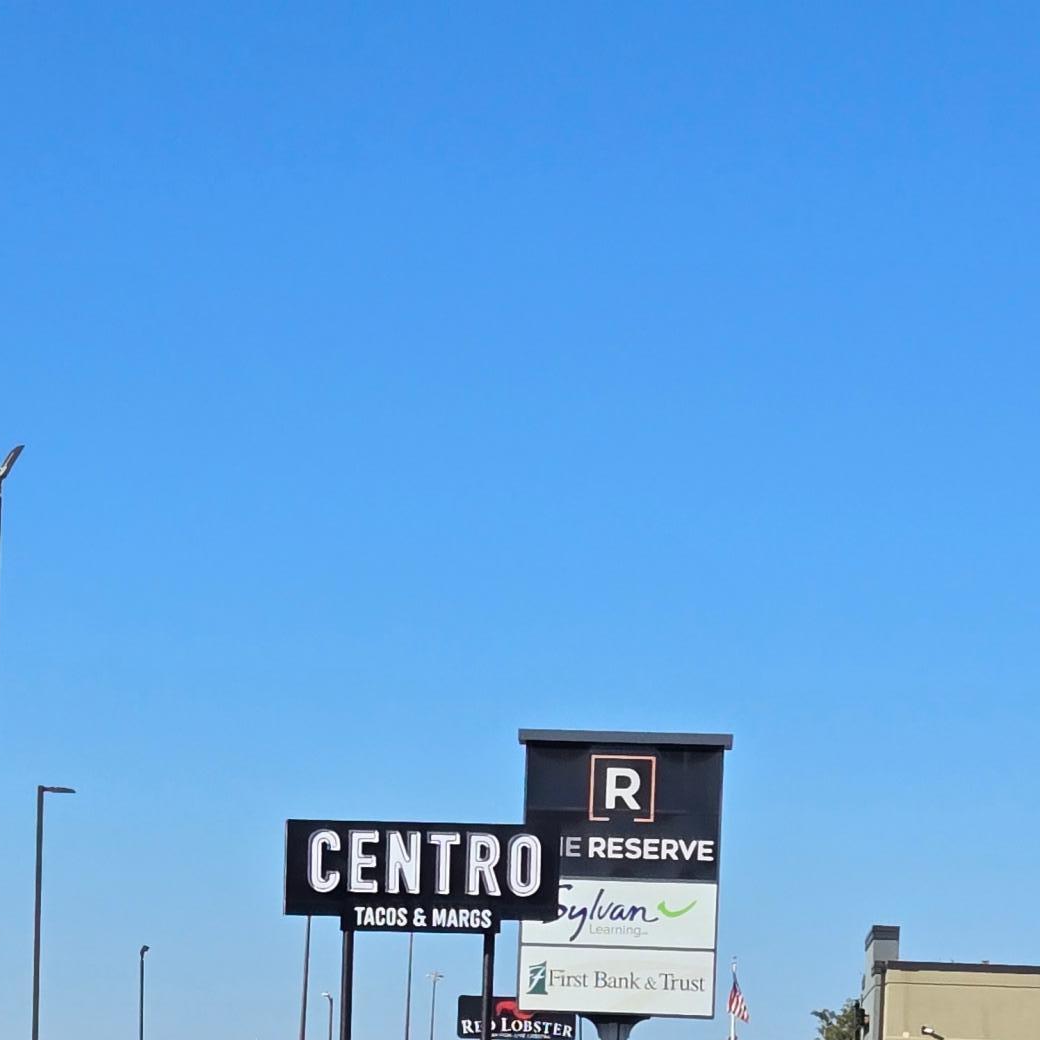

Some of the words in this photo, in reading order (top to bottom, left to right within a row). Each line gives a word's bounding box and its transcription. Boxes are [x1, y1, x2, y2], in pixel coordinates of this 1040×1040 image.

[605, 767, 641, 810] R
[588, 836, 715, 862] RESERVE
[307, 829, 542, 898] CENTRO
[354, 906, 408, 927] TACOS
[412, 907, 427, 927] &
[432, 908, 493, 928] MARGS
[543, 883, 659, 942] Sylvan
[589, 924, 642, 938] Learning
[549, 969, 589, 988] First
[594, 971, 641, 992] Bank
[644, 976, 658, 991] &
[659, 972, 706, 992] Trust
[501, 1017, 573, 1038] LOBSTER
